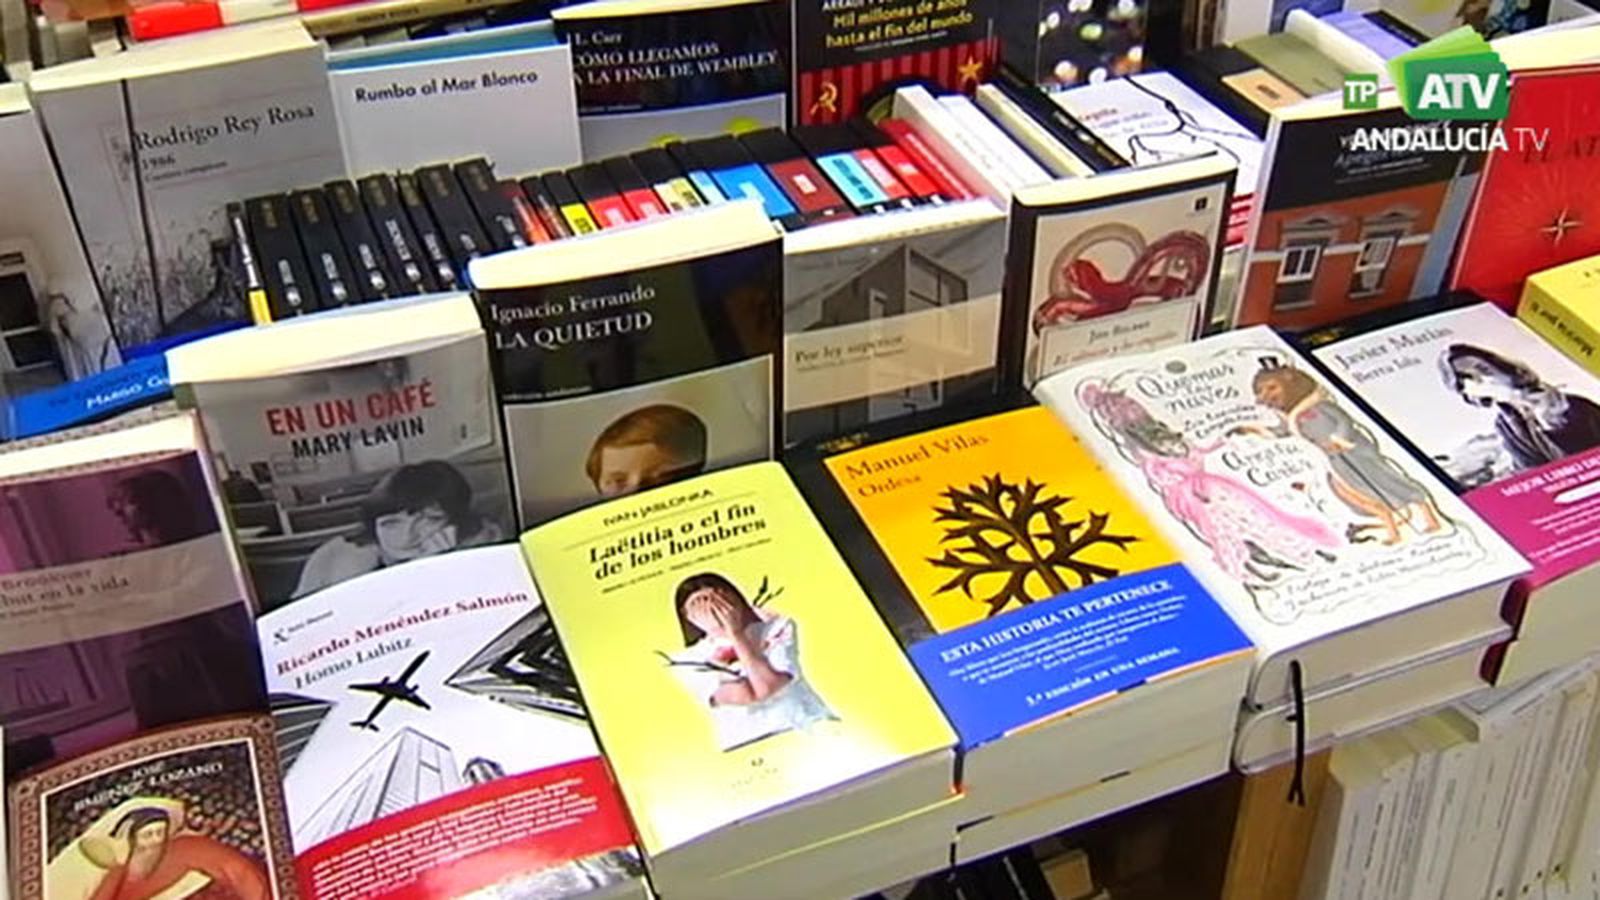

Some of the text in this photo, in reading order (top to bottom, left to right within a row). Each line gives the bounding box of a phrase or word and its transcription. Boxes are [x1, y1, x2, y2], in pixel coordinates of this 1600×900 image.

[826, 32, 865, 48] hasta
[869, 26, 881, 40] el
[885, 24, 903, 37] fin
[906, 18, 928, 34] del
[930, 11, 973, 29] mundo
[833, 13, 855, 28] Mil
[857, 6, 913, 25] millones
[916, 1, 933, 14] de
[592, 31, 622, 44] Carr
[629, 42, 720, 64] LLEGAMOS
[354, 69, 538, 102] Rumbo al Mar Blanco
[588, 70, 610, 85] LA
[614, 65, 667, 82] FINAL
[670, 63, 694, 77] DE
[697, 50, 779, 73] WEMBLEY
[133, 105, 314, 149] Rodrigo Rey Rosa
[490, 284, 656, 325] Ignacio Ferrando
[495, 310, 653, 350] LA QUIETUD
[795, 335, 903, 363] Por ley superior
[1335, 326, 1453, 370] Javier Marías
[1352, 356, 1423, 384] Berta Isla
[266, 378, 436, 436] EN UN CAFÉ
[291, 416, 425, 458] MARY LAVIN
[845, 434, 990, 479] Manuel Vilas
[858, 474, 921, 497] Ordesa
[589, 503, 757, 564] Laëtitia o el fin
[595, 518, 767, 581] de los hombres
[65, 583, 84, 597] la
[90, 575, 130, 593] vida
[277, 635, 351, 676] Ricardo
[354, 605, 451, 643] Menéndez
[455, 591, 528, 613] Salmón
[941, 580, 1173, 663] ESTA HISTORIA TE PERTENECE
[294, 637, 413, 689] Homo Lubitz
[149, 762, 224, 787] LOZANO
